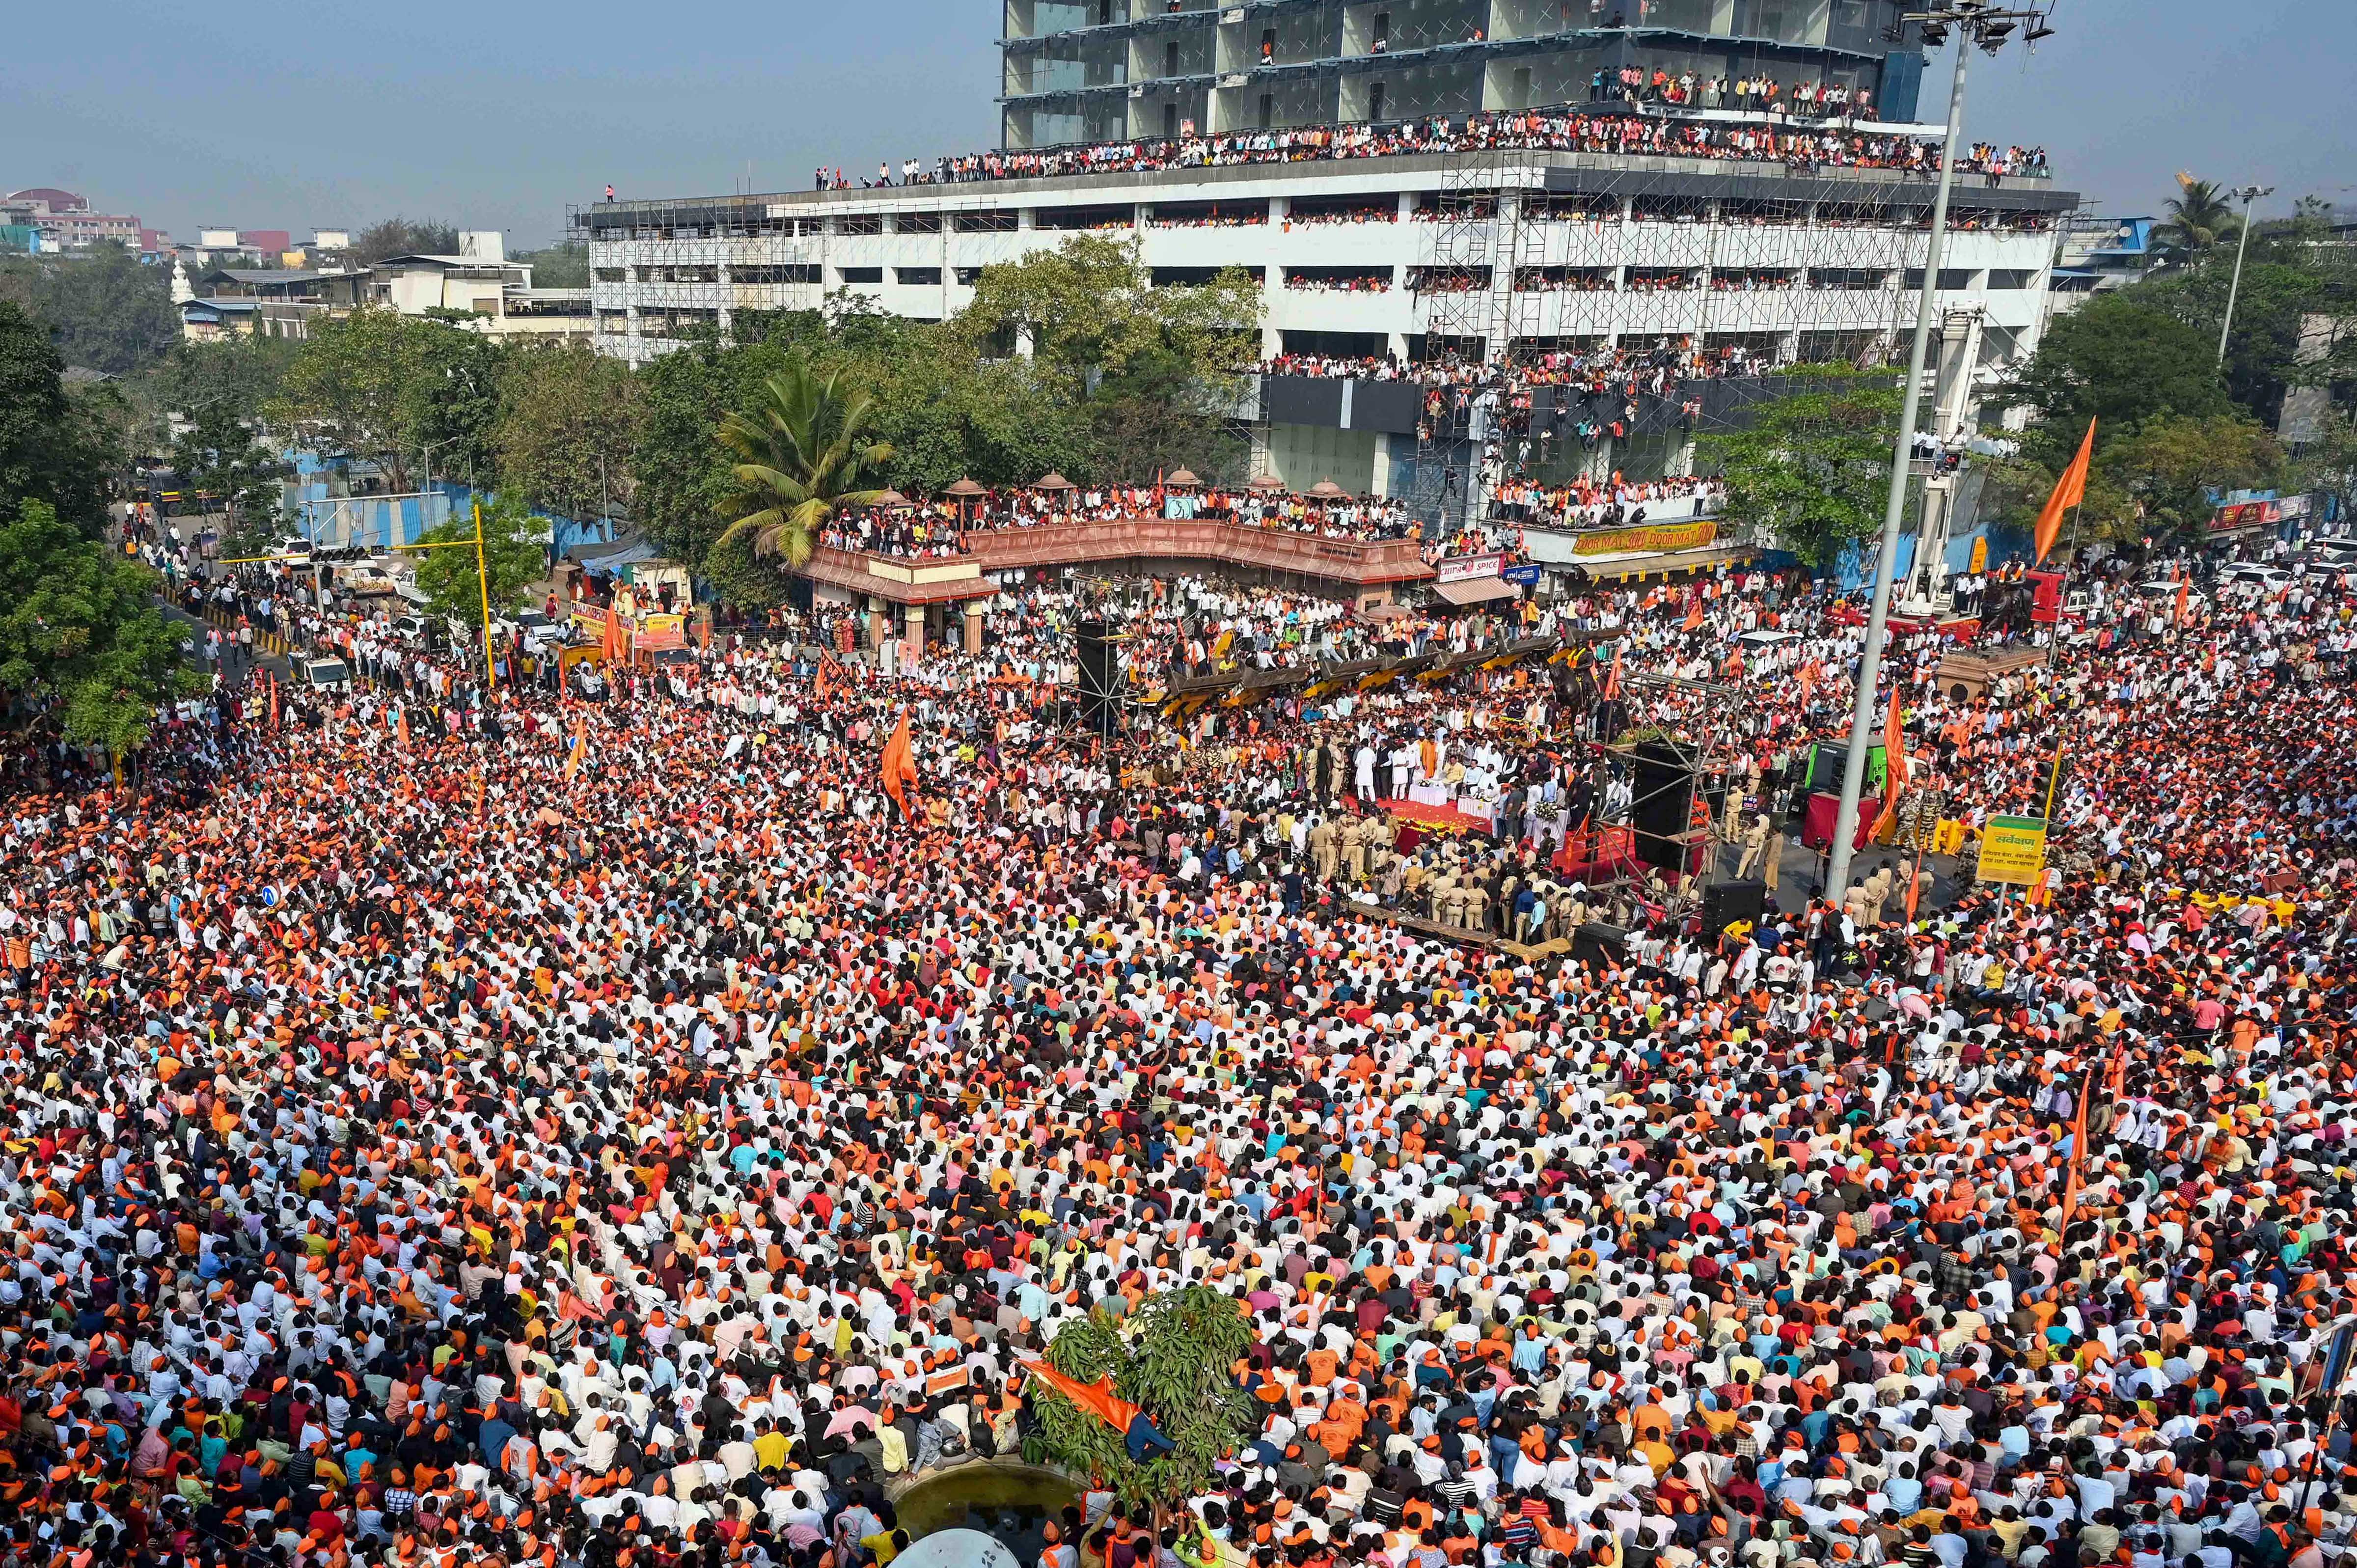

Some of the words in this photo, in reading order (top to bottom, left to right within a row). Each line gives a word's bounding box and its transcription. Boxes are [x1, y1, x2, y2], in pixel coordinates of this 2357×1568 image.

[1576, 538, 1599, 549] DOOR
[1601, 535, 1624, 548] MAT
[1649, 533, 1672, 545] DOOR
[1674, 530, 1696, 544] MAT
[1477, 561, 1498, 571] SPICE
[1995, 834, 2035, 846] सर्वेक्षण
